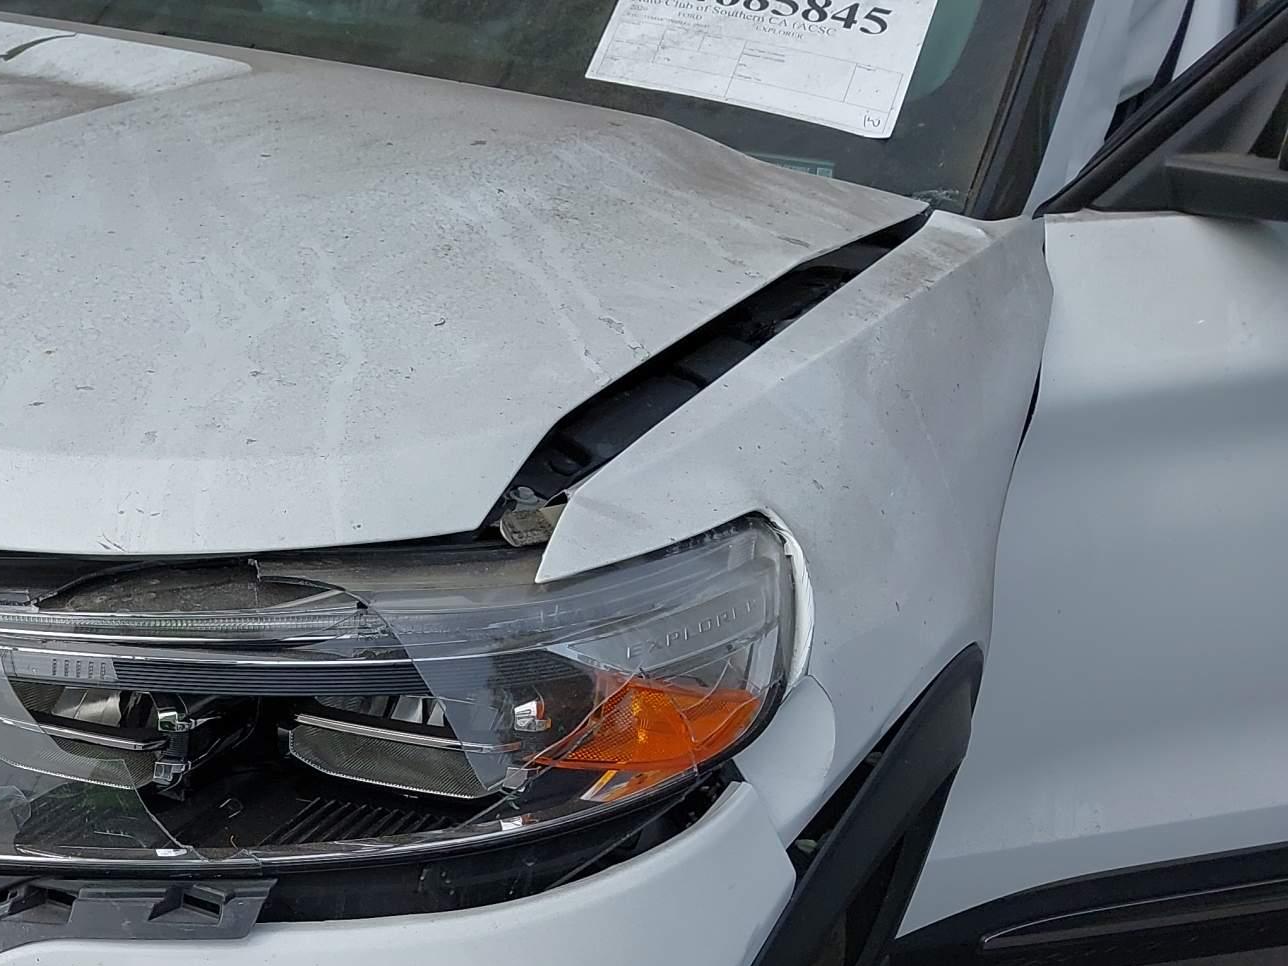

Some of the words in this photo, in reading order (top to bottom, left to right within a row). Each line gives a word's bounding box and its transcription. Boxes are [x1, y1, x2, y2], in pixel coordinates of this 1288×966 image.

[665, 0, 694, 9] Club
[712, 6, 765, 23] Southern
[769, 16, 788, 27] CA
[677, 11, 703, 20] FORD
[756, 26, 805, 39] EXPLORER
